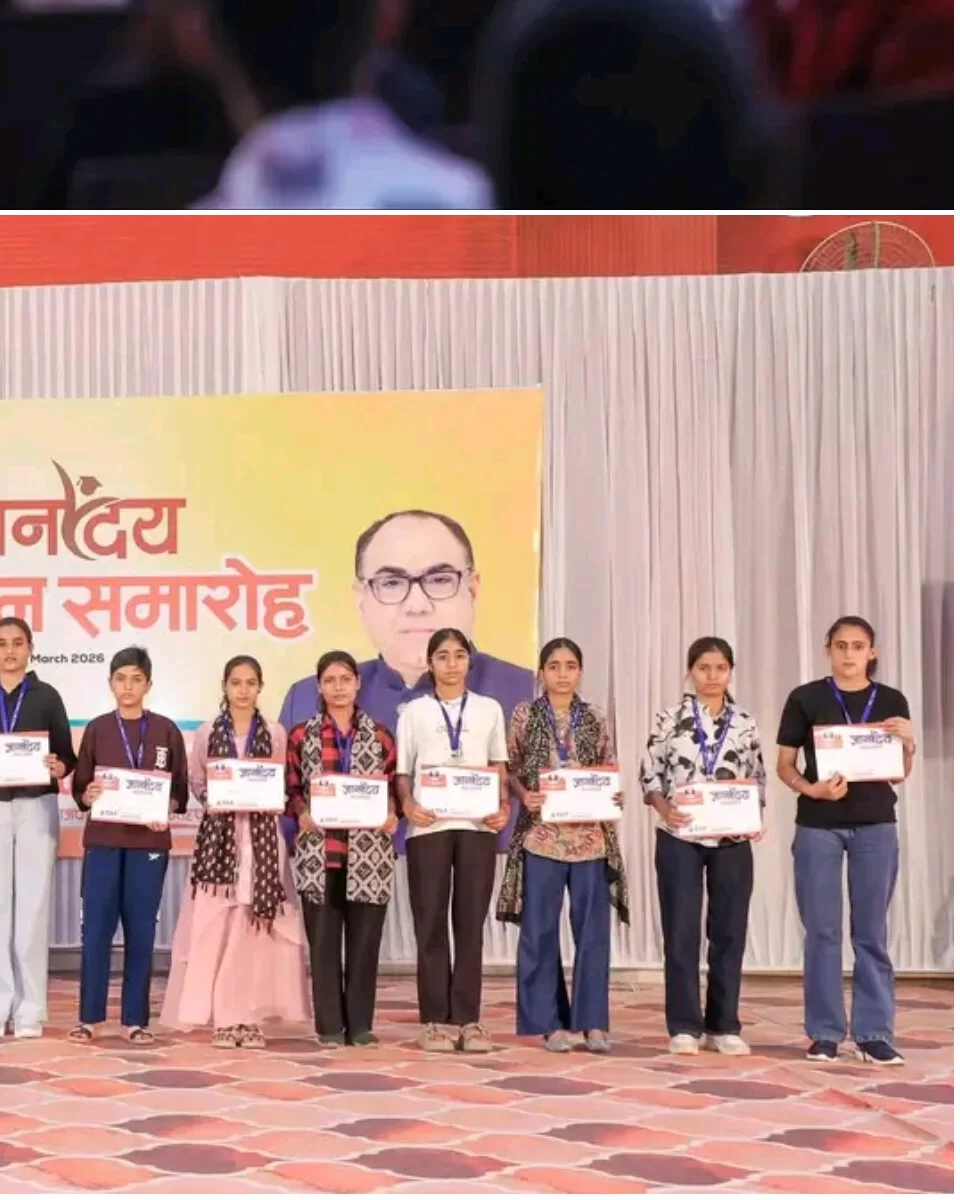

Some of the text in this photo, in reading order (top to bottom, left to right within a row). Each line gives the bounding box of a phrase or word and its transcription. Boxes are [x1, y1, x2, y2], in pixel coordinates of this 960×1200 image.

[58, 558, 314, 639] समारोह
[30, 652, 105, 664] March 2026
